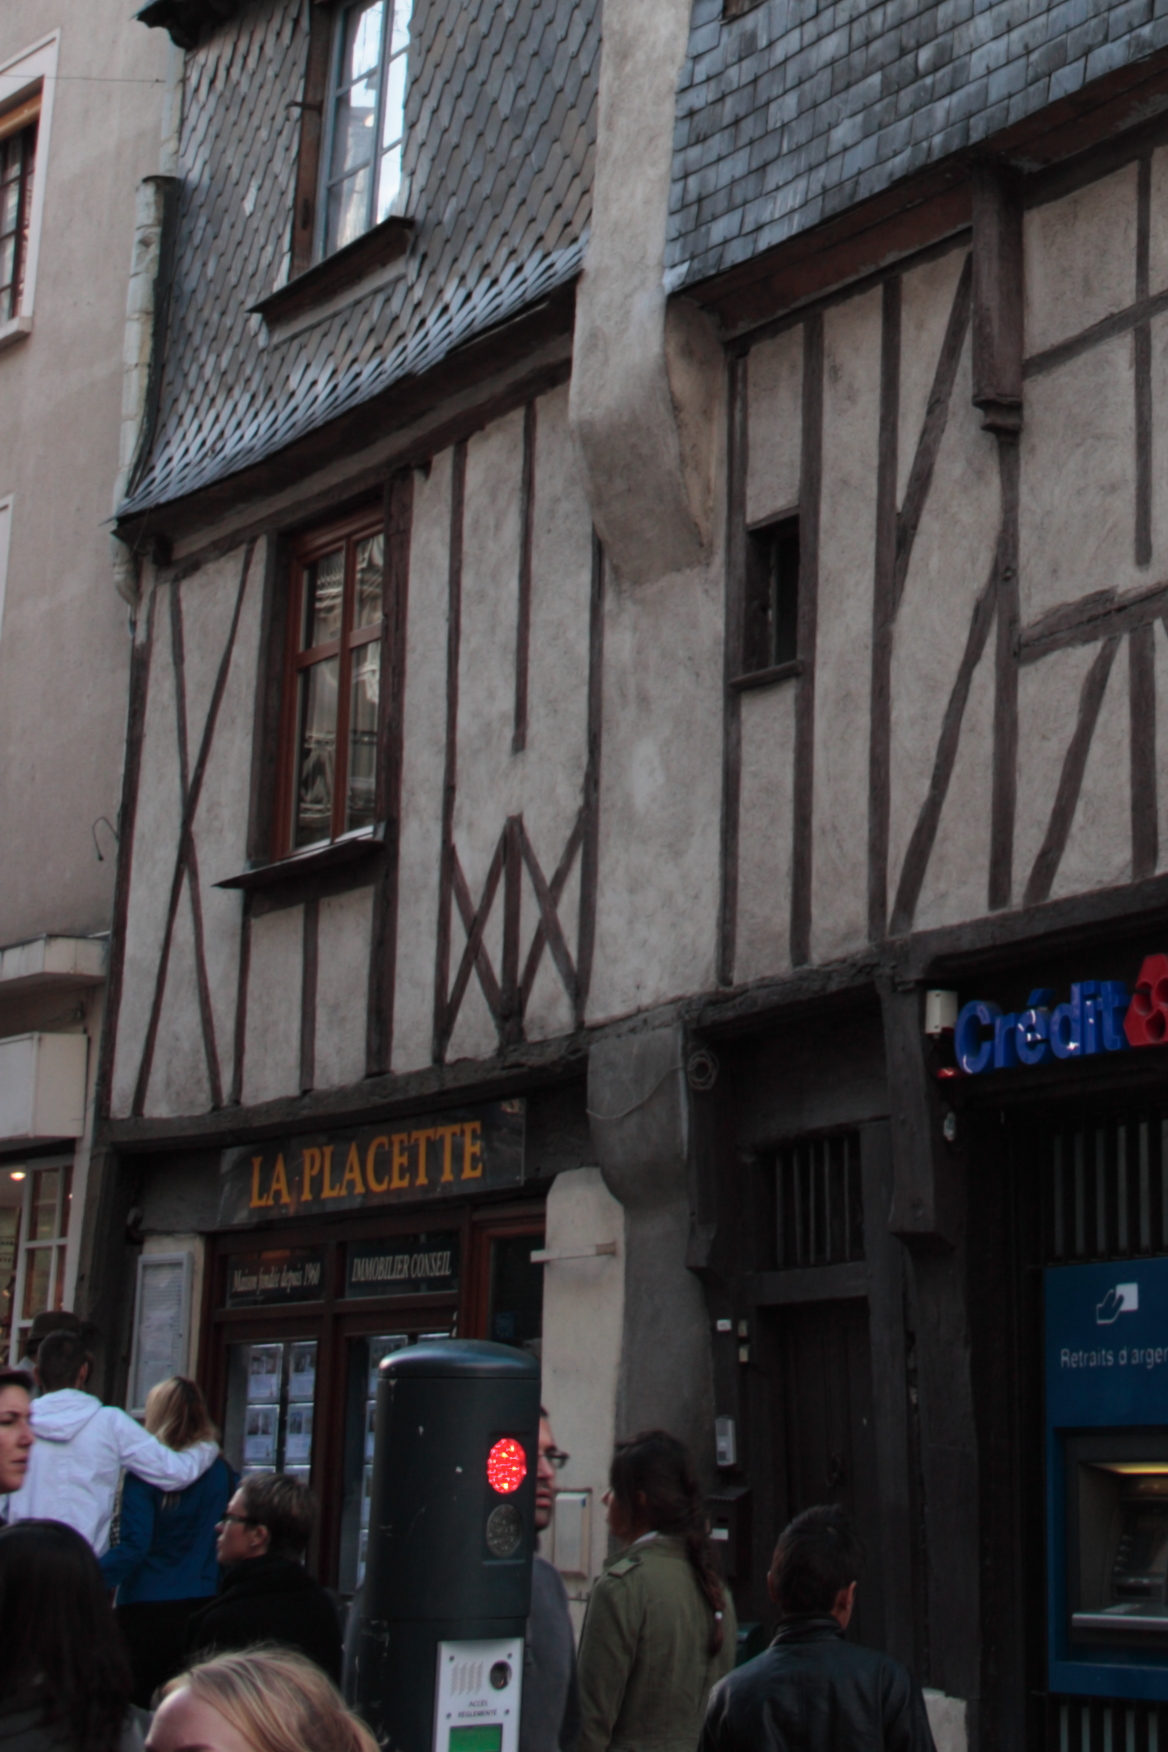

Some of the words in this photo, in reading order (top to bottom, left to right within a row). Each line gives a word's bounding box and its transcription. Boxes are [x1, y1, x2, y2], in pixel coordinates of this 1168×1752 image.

[954, 979, 1131, 1074] Crédit
[250, 1151, 292, 1209] LA
[300, 1120, 483, 1203] PLACETTE
[231, 1268, 257, 1293] Maison
[280, 1263, 302, 1294] depuis
[302, 1261, 322, 1286] 1960
[351, 1254, 409, 1283] IMMOBILIER
[410, 1250, 452, 1279] CONSEIL
[1060, 1346, 1115, 1368] Retraits
